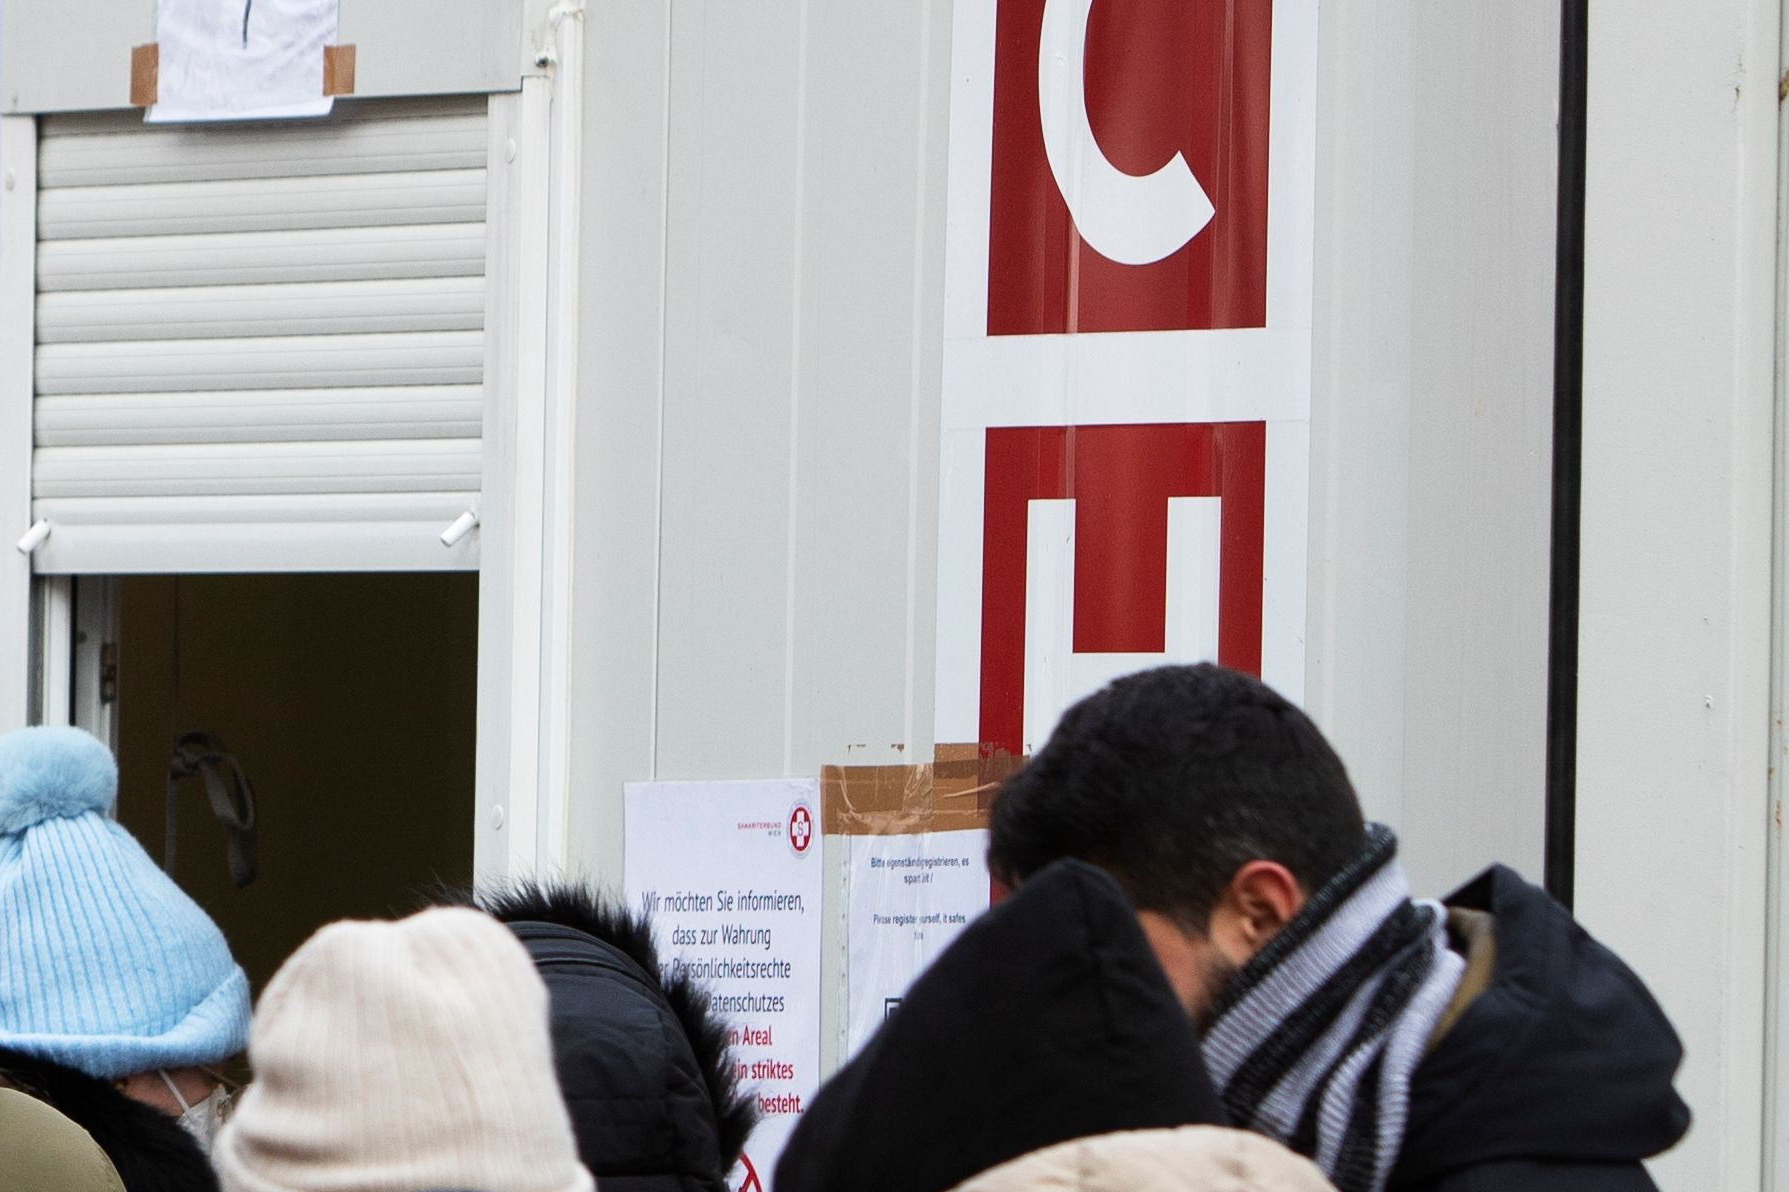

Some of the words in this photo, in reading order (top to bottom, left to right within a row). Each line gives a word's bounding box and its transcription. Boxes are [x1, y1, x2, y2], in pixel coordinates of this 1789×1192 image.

[642, 891, 661, 912] Wir
[664, 891, 713, 912] möchten
[717, 891, 733, 913] Sie
[737, 890, 805, 914] informieren,
[672, 924, 697, 946] dass
[700, 929, 718, 946] zur
[721, 924, 771, 950] Wahrung
[673, 957, 792, 979] Persönlichkeitsrechte
[742, 1025, 773, 1046] Areal
[752, 1058, 794, 1079] striktes
[757, 1091, 804, 1114] besteht.
